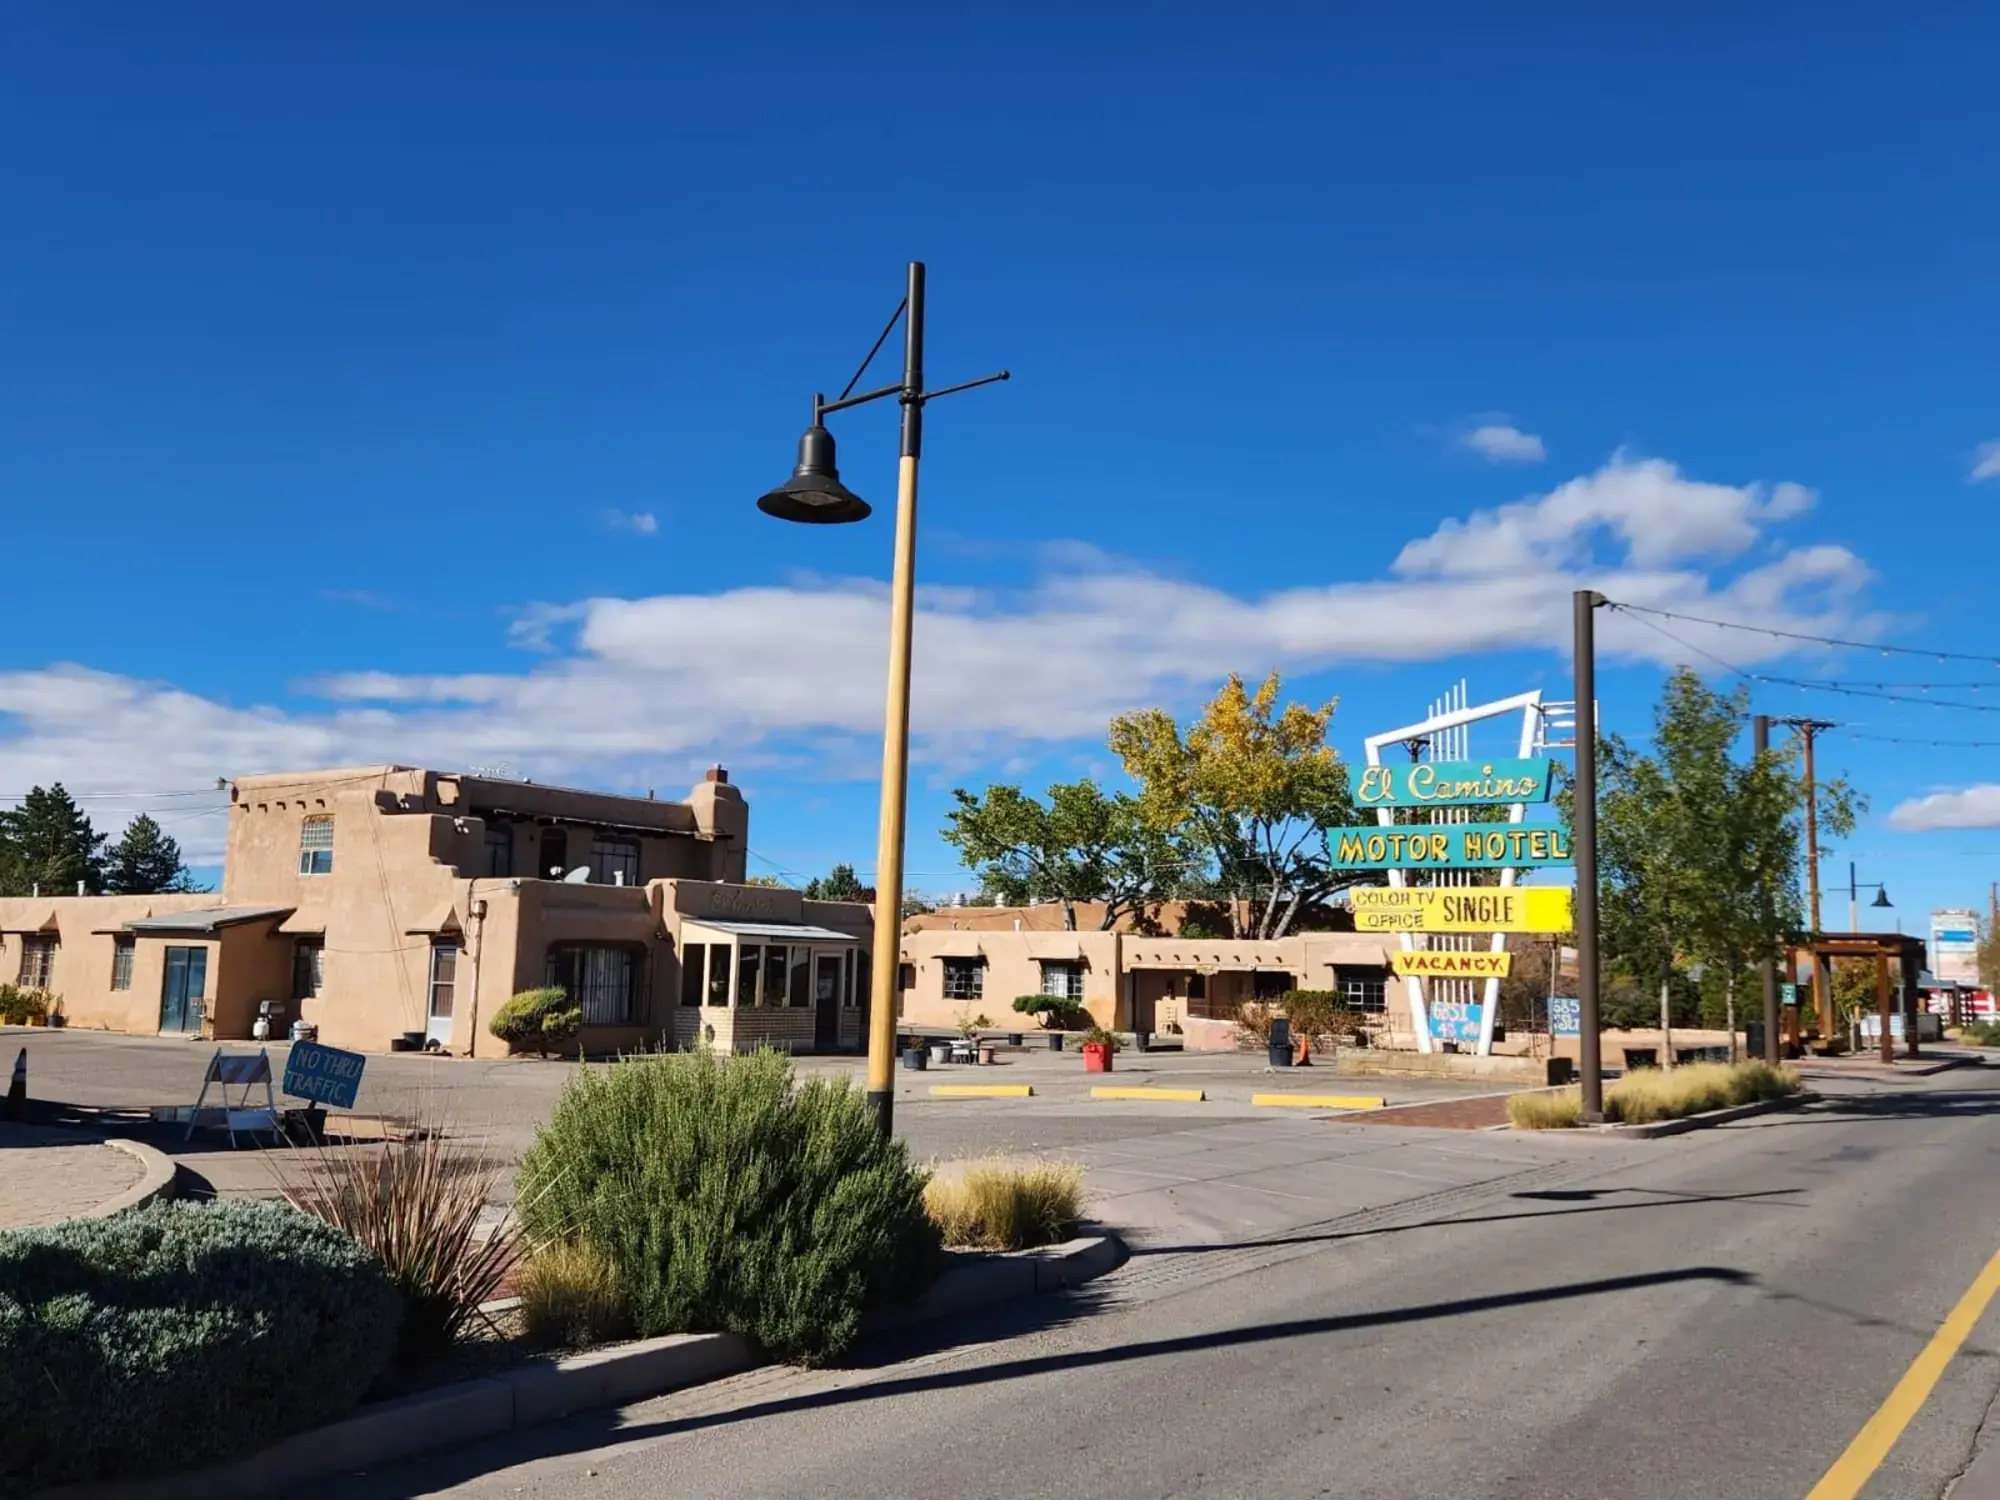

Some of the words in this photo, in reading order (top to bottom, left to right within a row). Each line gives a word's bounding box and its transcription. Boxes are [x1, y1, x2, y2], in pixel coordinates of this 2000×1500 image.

[1358, 767, 1396, 801] El
[1408, 765, 1537, 800] Camino
[1338, 832, 1450, 863] MOTOR
[1464, 830, 1571, 860] HOTEL
[1356, 891, 1411, 906] COLOR
[1415, 892, 1435, 905] TV
[1443, 895, 1513, 922] SINGLE
[1367, 914, 1424, 928] OFFICE
[1403, 956, 1502, 971] VACANCY
[296, 1048, 320, 1069] NO
[323, 1053, 363, 1078] THRU
[287, 1070, 347, 1104] TRAFFIC
